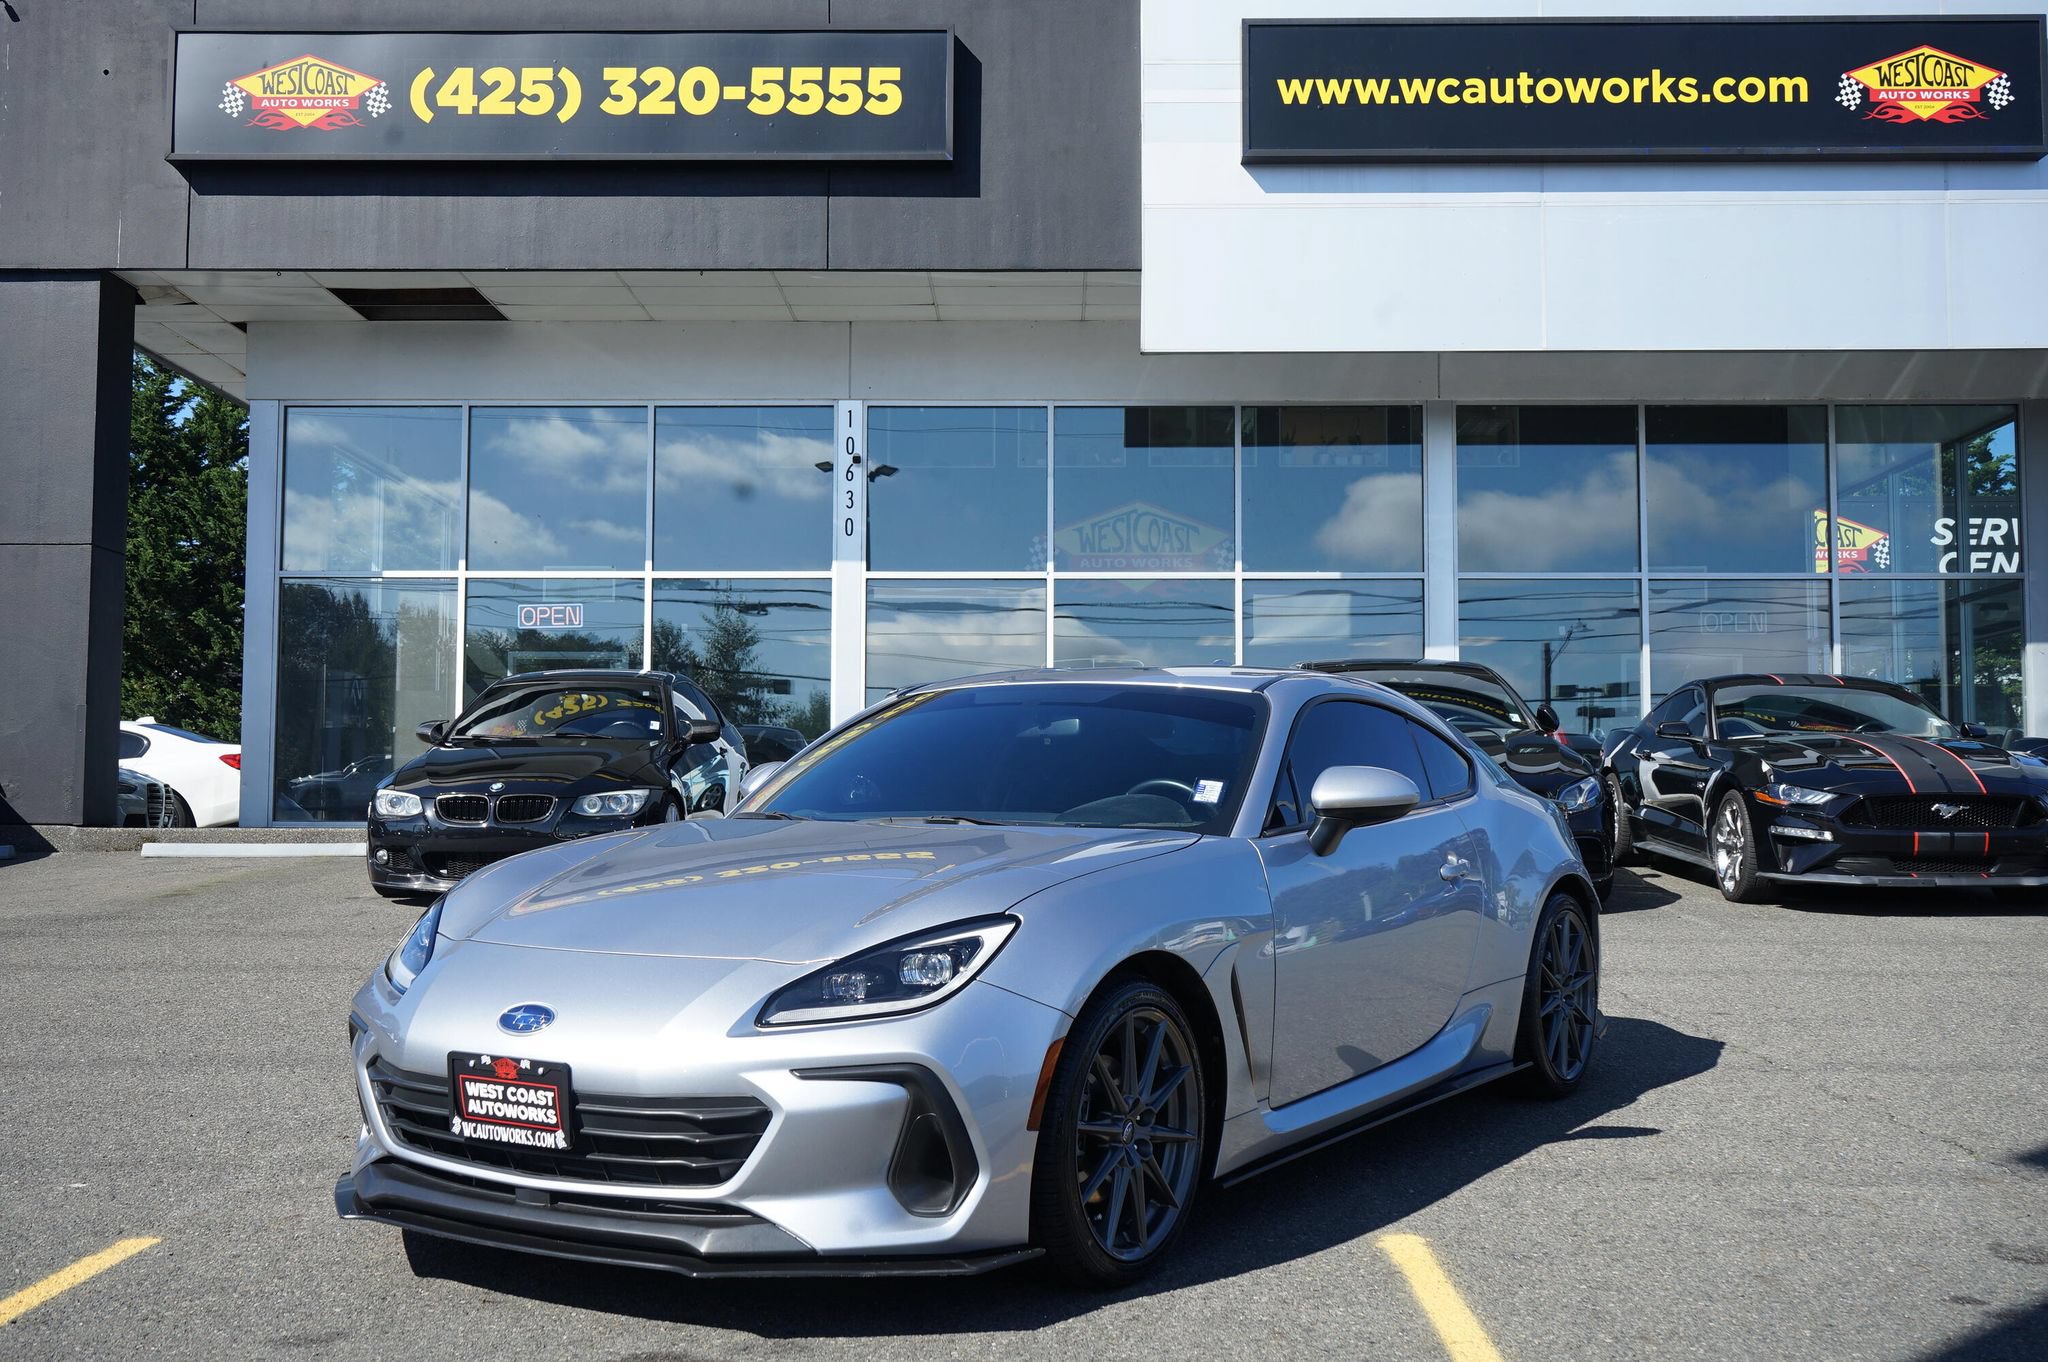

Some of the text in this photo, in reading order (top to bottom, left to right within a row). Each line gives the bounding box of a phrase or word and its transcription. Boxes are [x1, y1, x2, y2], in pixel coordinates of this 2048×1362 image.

[409, 66, 903, 124] (425) 320-5555
[1276, 69, 1809, 105] www.wcautoworks.com
[1878, 90, 1971, 100] AUTO WORKS
[260, 98, 350, 107] AUTO WORKS
[845, 409, 857, 537] 10630
[1079, 557, 1193, 569] AUTO WORKS
[521, 606, 580, 626] OPEN
[1703, 612, 1764, 633] OPEN
[465, 1081, 555, 1107] WEST COAST
[467, 1098, 558, 1125] AUTOWORKS
[461, 1121, 556, 1149] WCAUTOWORKS.COM
